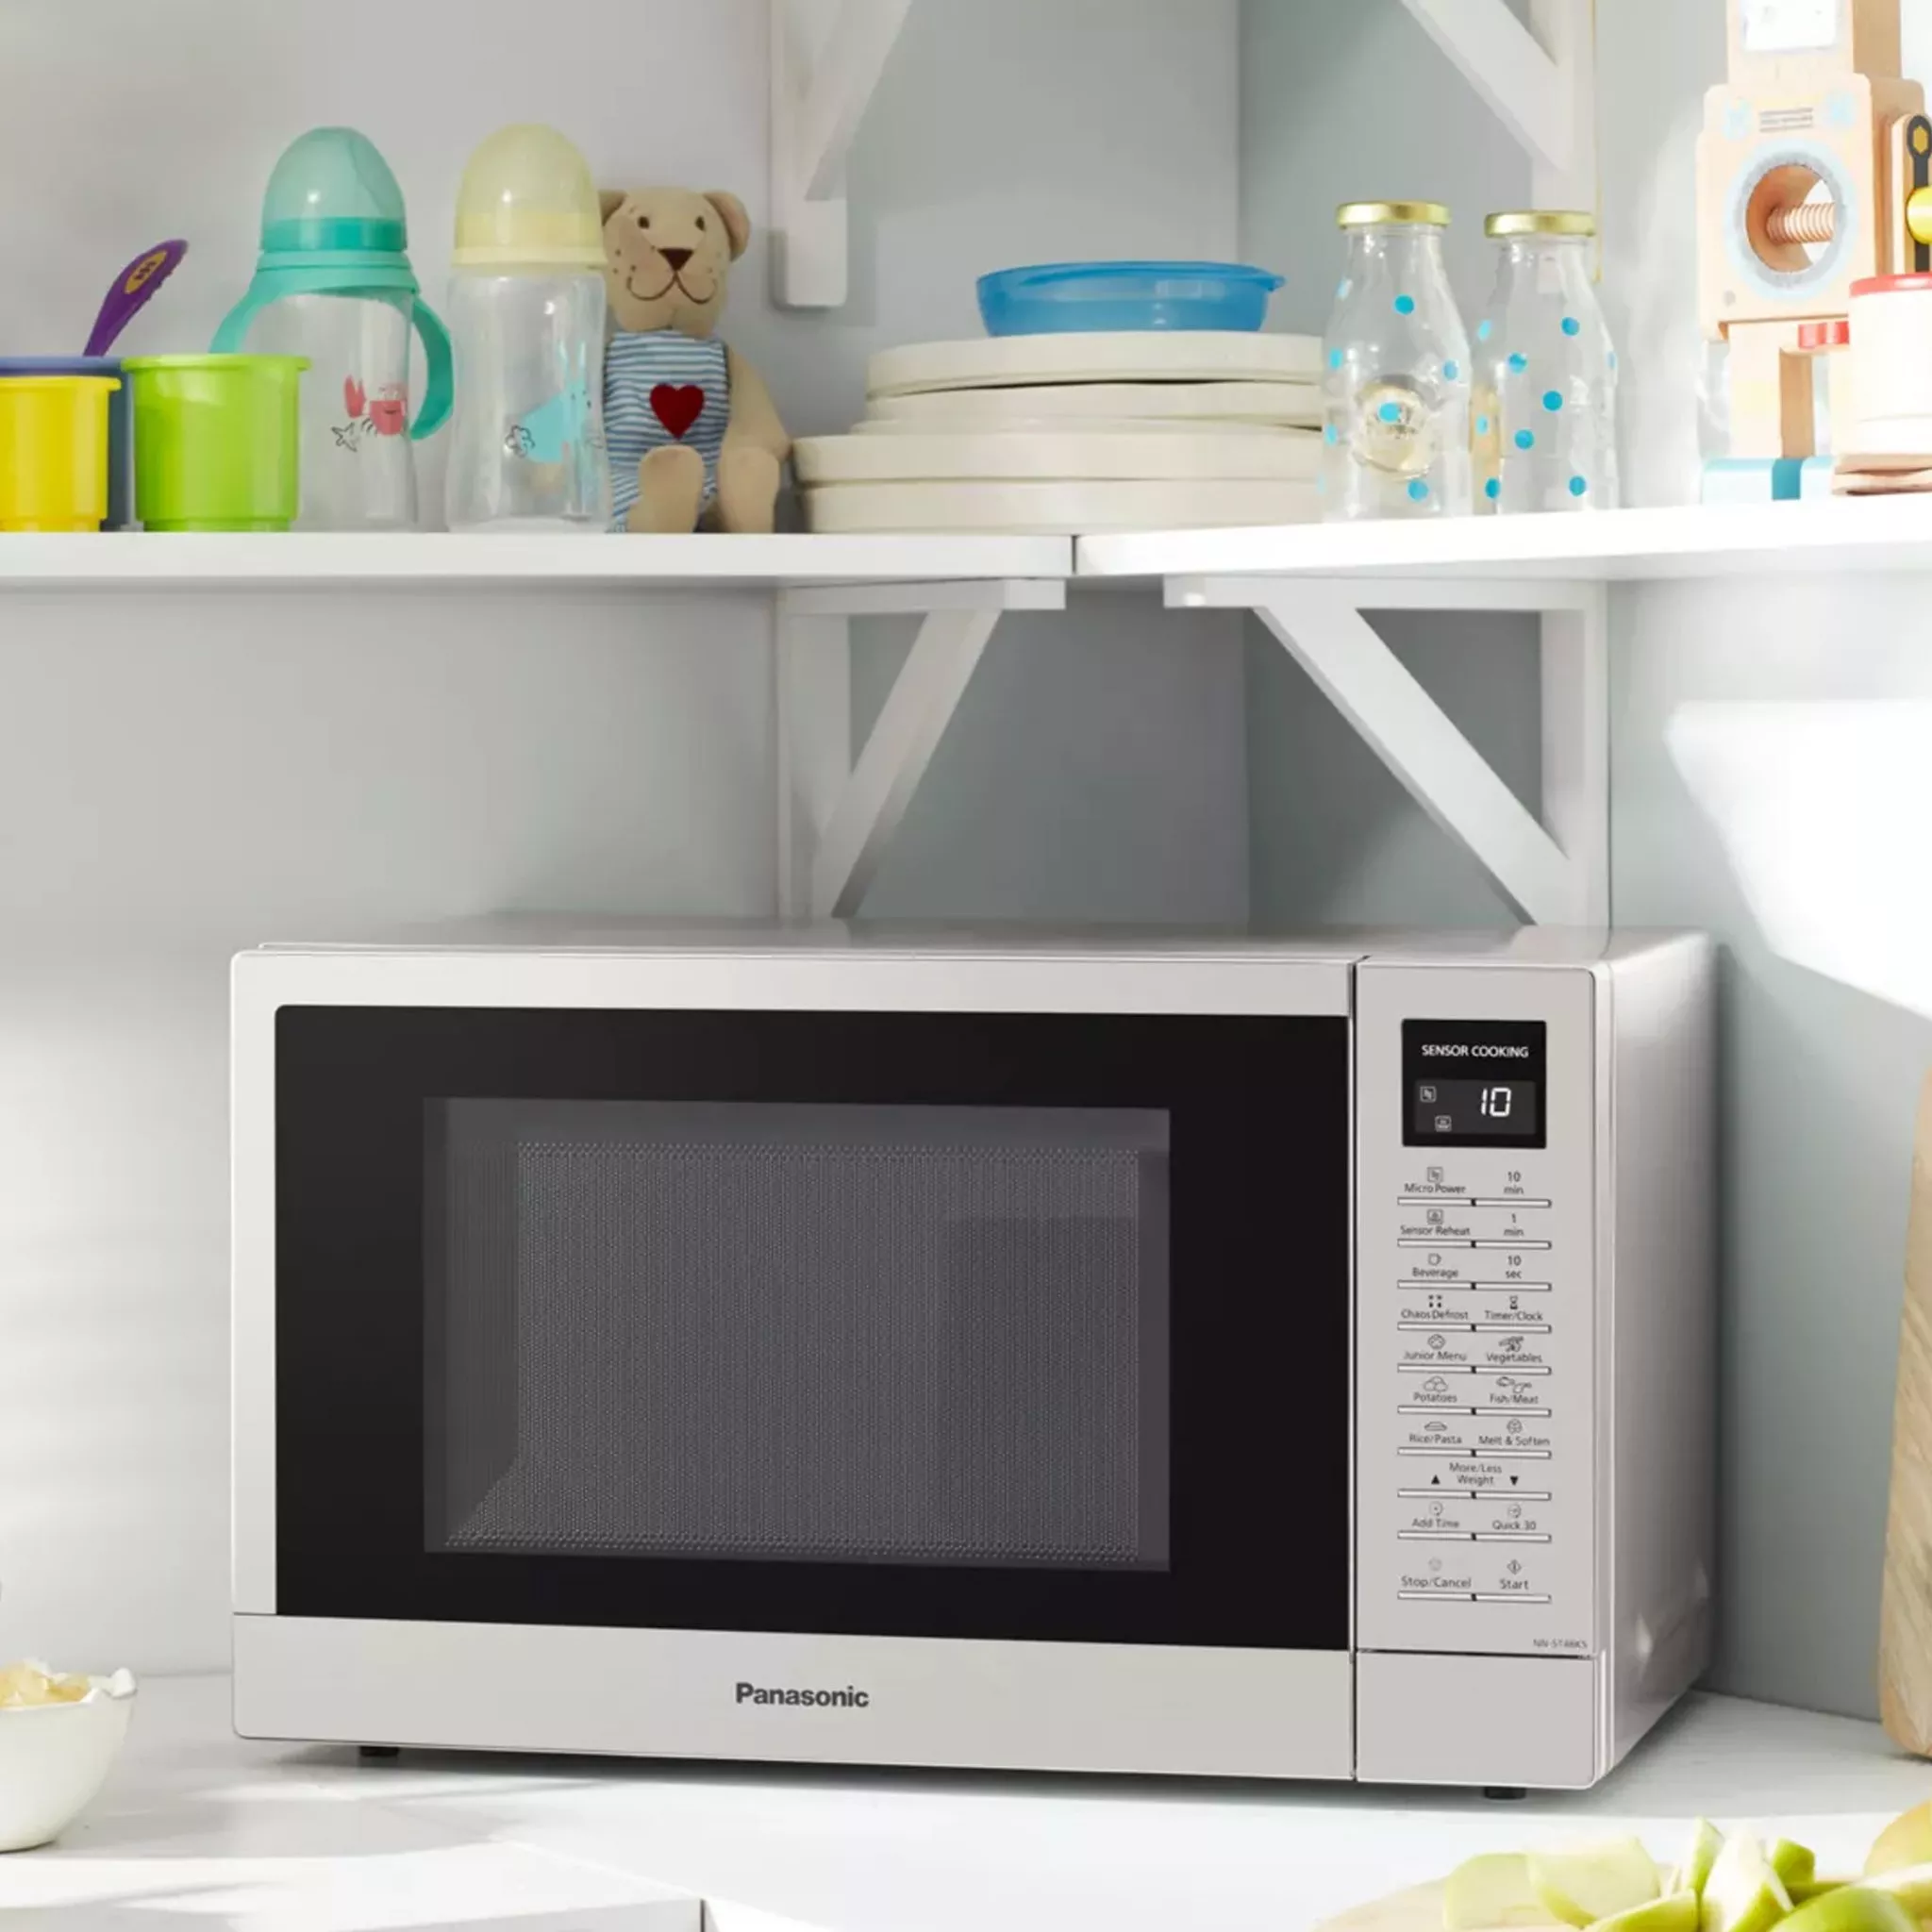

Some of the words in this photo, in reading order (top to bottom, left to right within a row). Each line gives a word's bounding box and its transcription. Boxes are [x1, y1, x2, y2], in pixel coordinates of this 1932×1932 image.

[1422, 1044, 1469, 1057] SENSOR
[1471, 1045, 1529, 1058] COOKING
[1480, 1087, 1512, 1117] 10
[1507, 1171, 1522, 1182] 10
[1504, 1185, 1524, 1195] min
[1400, 1224, 1432, 1236] Sensor
[1435, 1225, 1471, 1237] Reheat
[1504, 1226, 1524, 1237] min
[1507, 1255, 1522, 1266] 10
[1412, 1267, 1459, 1279] Beverage
[1505, 1270, 1523, 1279] sec
[1484, 1310, 1544, 1322] Timer/Clock
[1403, 1351, 1435, 1361] Junior
[1437, 1351, 1468, 1362] Menu
[1486, 1352, 1543, 1365] Vegetables
[1413, 1391, 1458, 1404] Potatoes
[1408, 1433, 1463, 1445] Rice/Pasta
[1478, 1435, 1503, 1446] Melt
[1505, 1436, 1513, 1446] &
[1515, 1435, 1551, 1447] Soften
[1449, 1462, 1503, 1474] More/Less
[1457, 1474, 1494, 1488] Weight
[1411, 1518, 1433, 1528] Add
[1435, 1518, 1460, 1529] Time
[1491, 1520, 1521, 1531] Quick
[1523, 1521, 1537, 1531] 30
[1401, 1575, 1472, 1590] Stop/Cancel
[1500, 1578, 1529, 1591] Start
[735, 1681, 871, 1708] Panasonic
